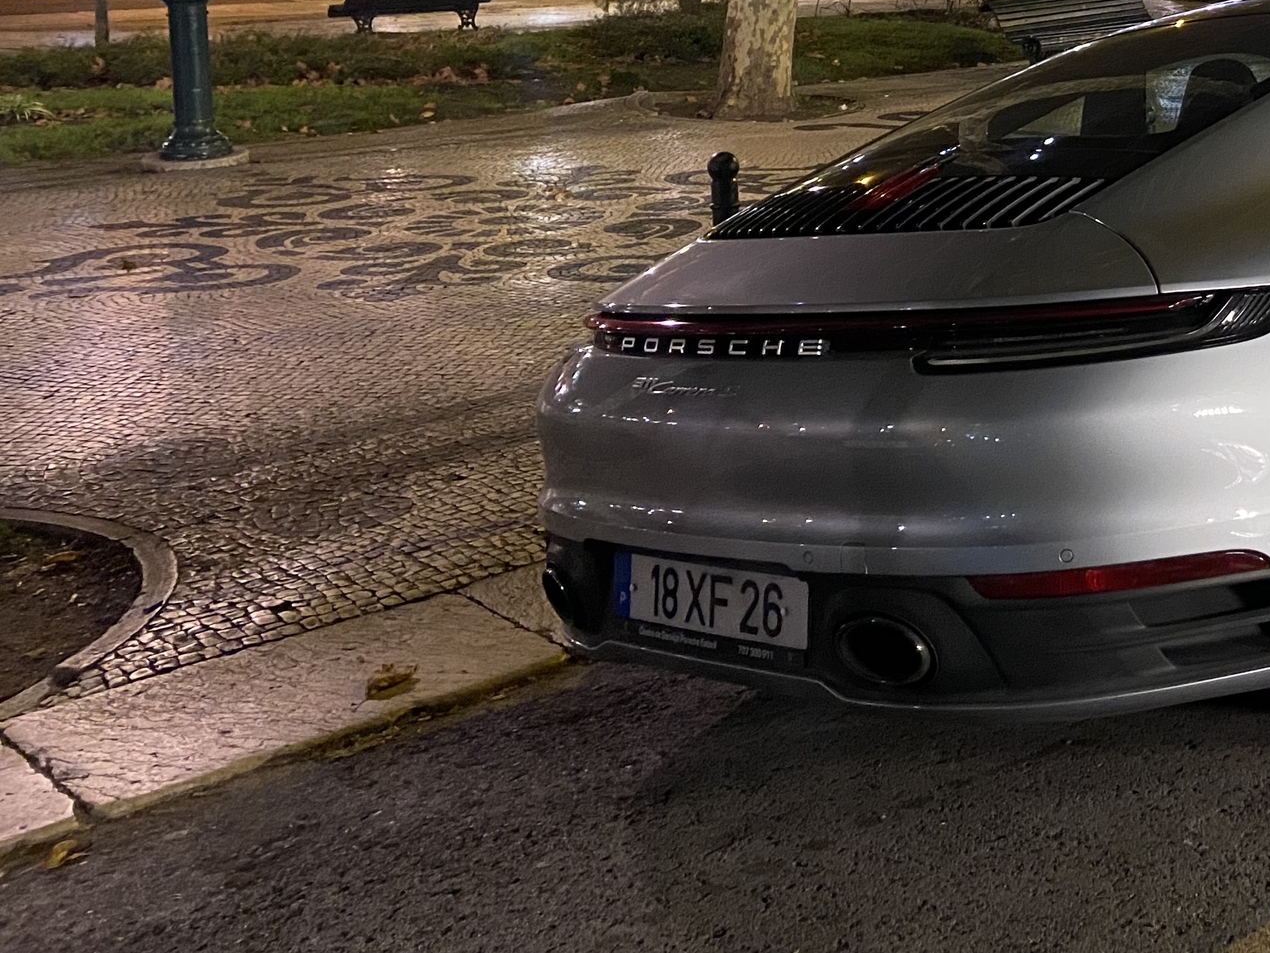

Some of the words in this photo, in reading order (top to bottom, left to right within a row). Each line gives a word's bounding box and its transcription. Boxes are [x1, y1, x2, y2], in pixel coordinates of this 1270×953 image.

[621, 337, 823, 356] PORSCHE
[651, 564, 679, 619] 18
[684, 569, 733, 628] XF
[739, 579, 783, 638] 26
